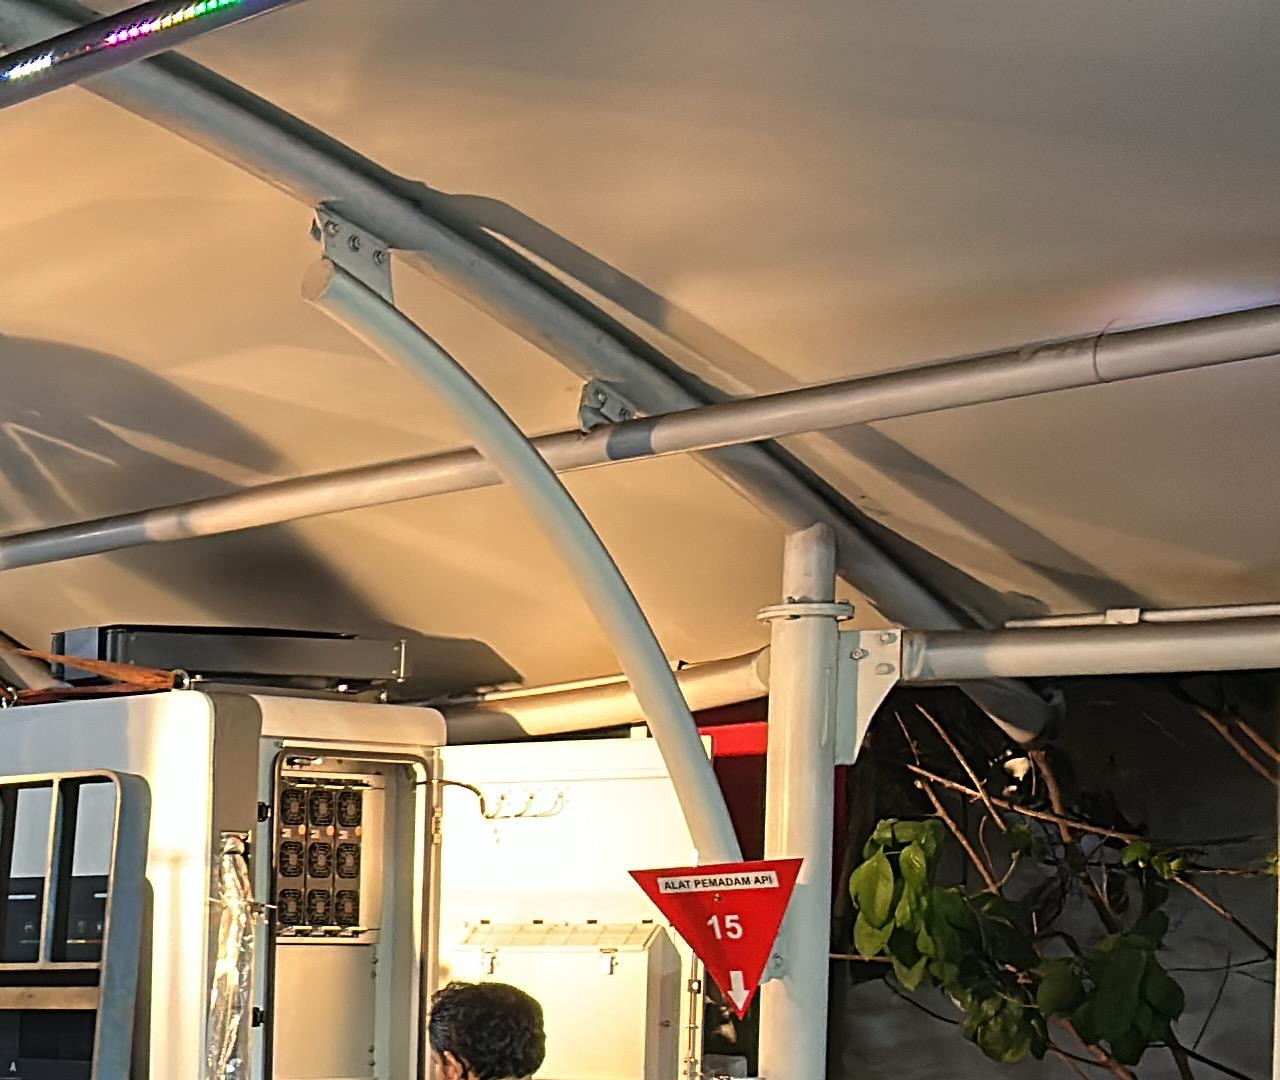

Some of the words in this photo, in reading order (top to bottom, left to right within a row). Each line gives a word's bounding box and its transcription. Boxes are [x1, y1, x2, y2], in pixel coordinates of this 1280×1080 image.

[664, 880, 690, 890] ALAT
[694, 876, 751, 888] PEMADAM
[754, 875, 772, 885] API
[707, 914, 743, 940] 15
[9, 1061, 17, 1072] A
